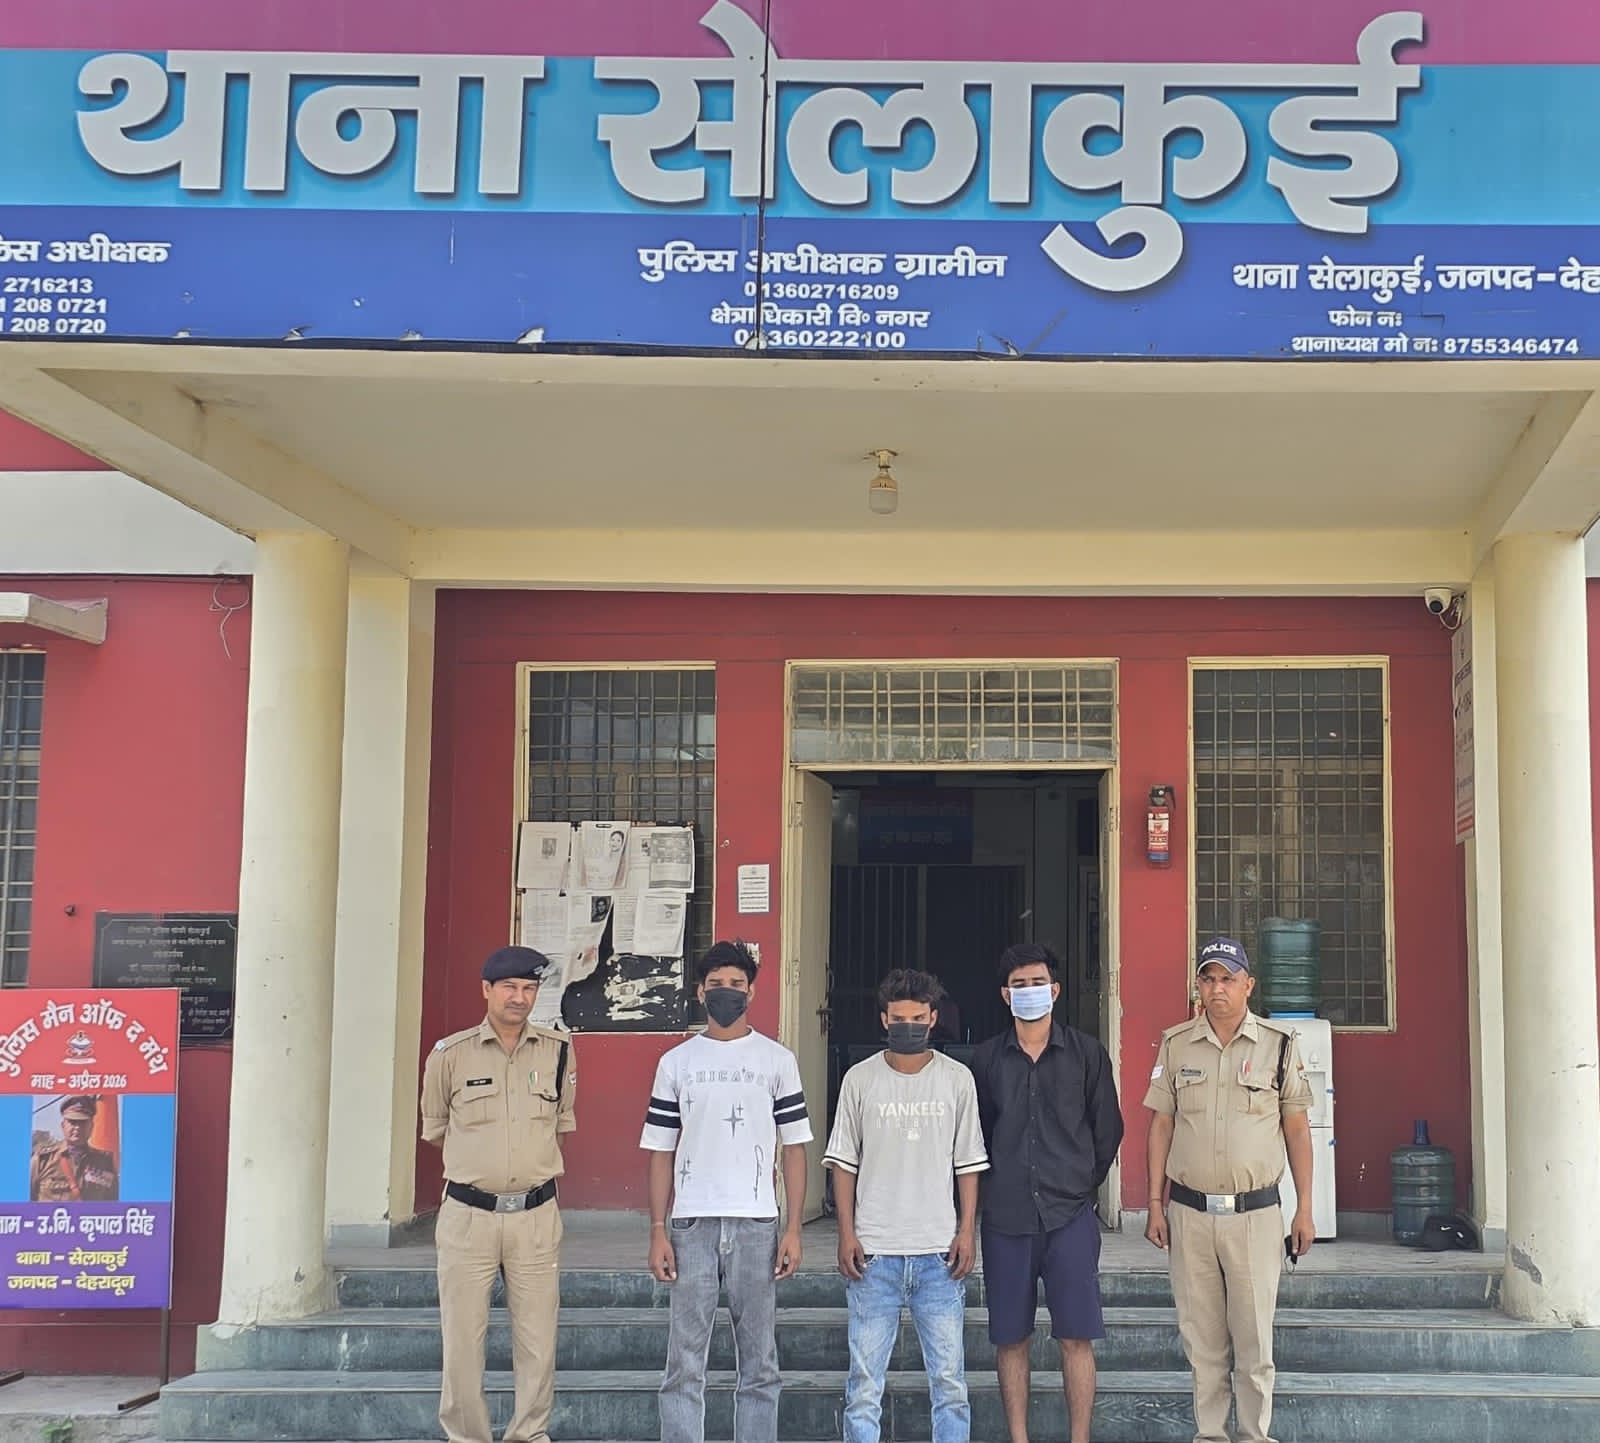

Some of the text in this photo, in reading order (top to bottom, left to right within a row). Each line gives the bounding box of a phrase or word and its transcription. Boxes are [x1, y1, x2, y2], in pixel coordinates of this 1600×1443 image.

[76, 0, 1424, 292] थाना सेलाकुई
[46, 232, 172, 263] अधीक्षक
[637, 240, 1008, 283] पुलिस अधीक्षक ग्रामीन
[4, 277, 94, 294] 2716213
[1232, 264, 1299, 289] थाना
[744, 281, 899, 300] 013602716209
[13, 298, 52, 313] 208
[57, 298, 107, 313] 0721
[1328, 304, 1373, 327] फोन
[10, 317, 50, 333] 208
[55, 318, 106, 333] 0720
[875, 310, 931, 328] नगर
[734, 329, 906, 348] 0360222100
[1291, 336, 1380, 353] थानाध्यक्ष
[1384, 332, 1408, 353] मो
[1443, 338, 1579, 354] 8755346474
[1201, 943, 1237, 956] POLICE
[80, 998, 127, 1030] ऑफ
[126, 1020, 145, 1043] द
[31, 1074, 56, 1090] माह
[103, 1074, 127, 1089] 2026
[878, 1101, 945, 1118] YANKEES
[80, 1215, 124, 1242] कृपाल
[126, 1208, 155, 1235] सिंह
[16, 1251, 52, 1265] थाना
[68, 1246, 128, 1272] सेलाकुई
[8, 1275, 59, 1290] जनपद
[75, 1271, 136, 1297] देहरादून
